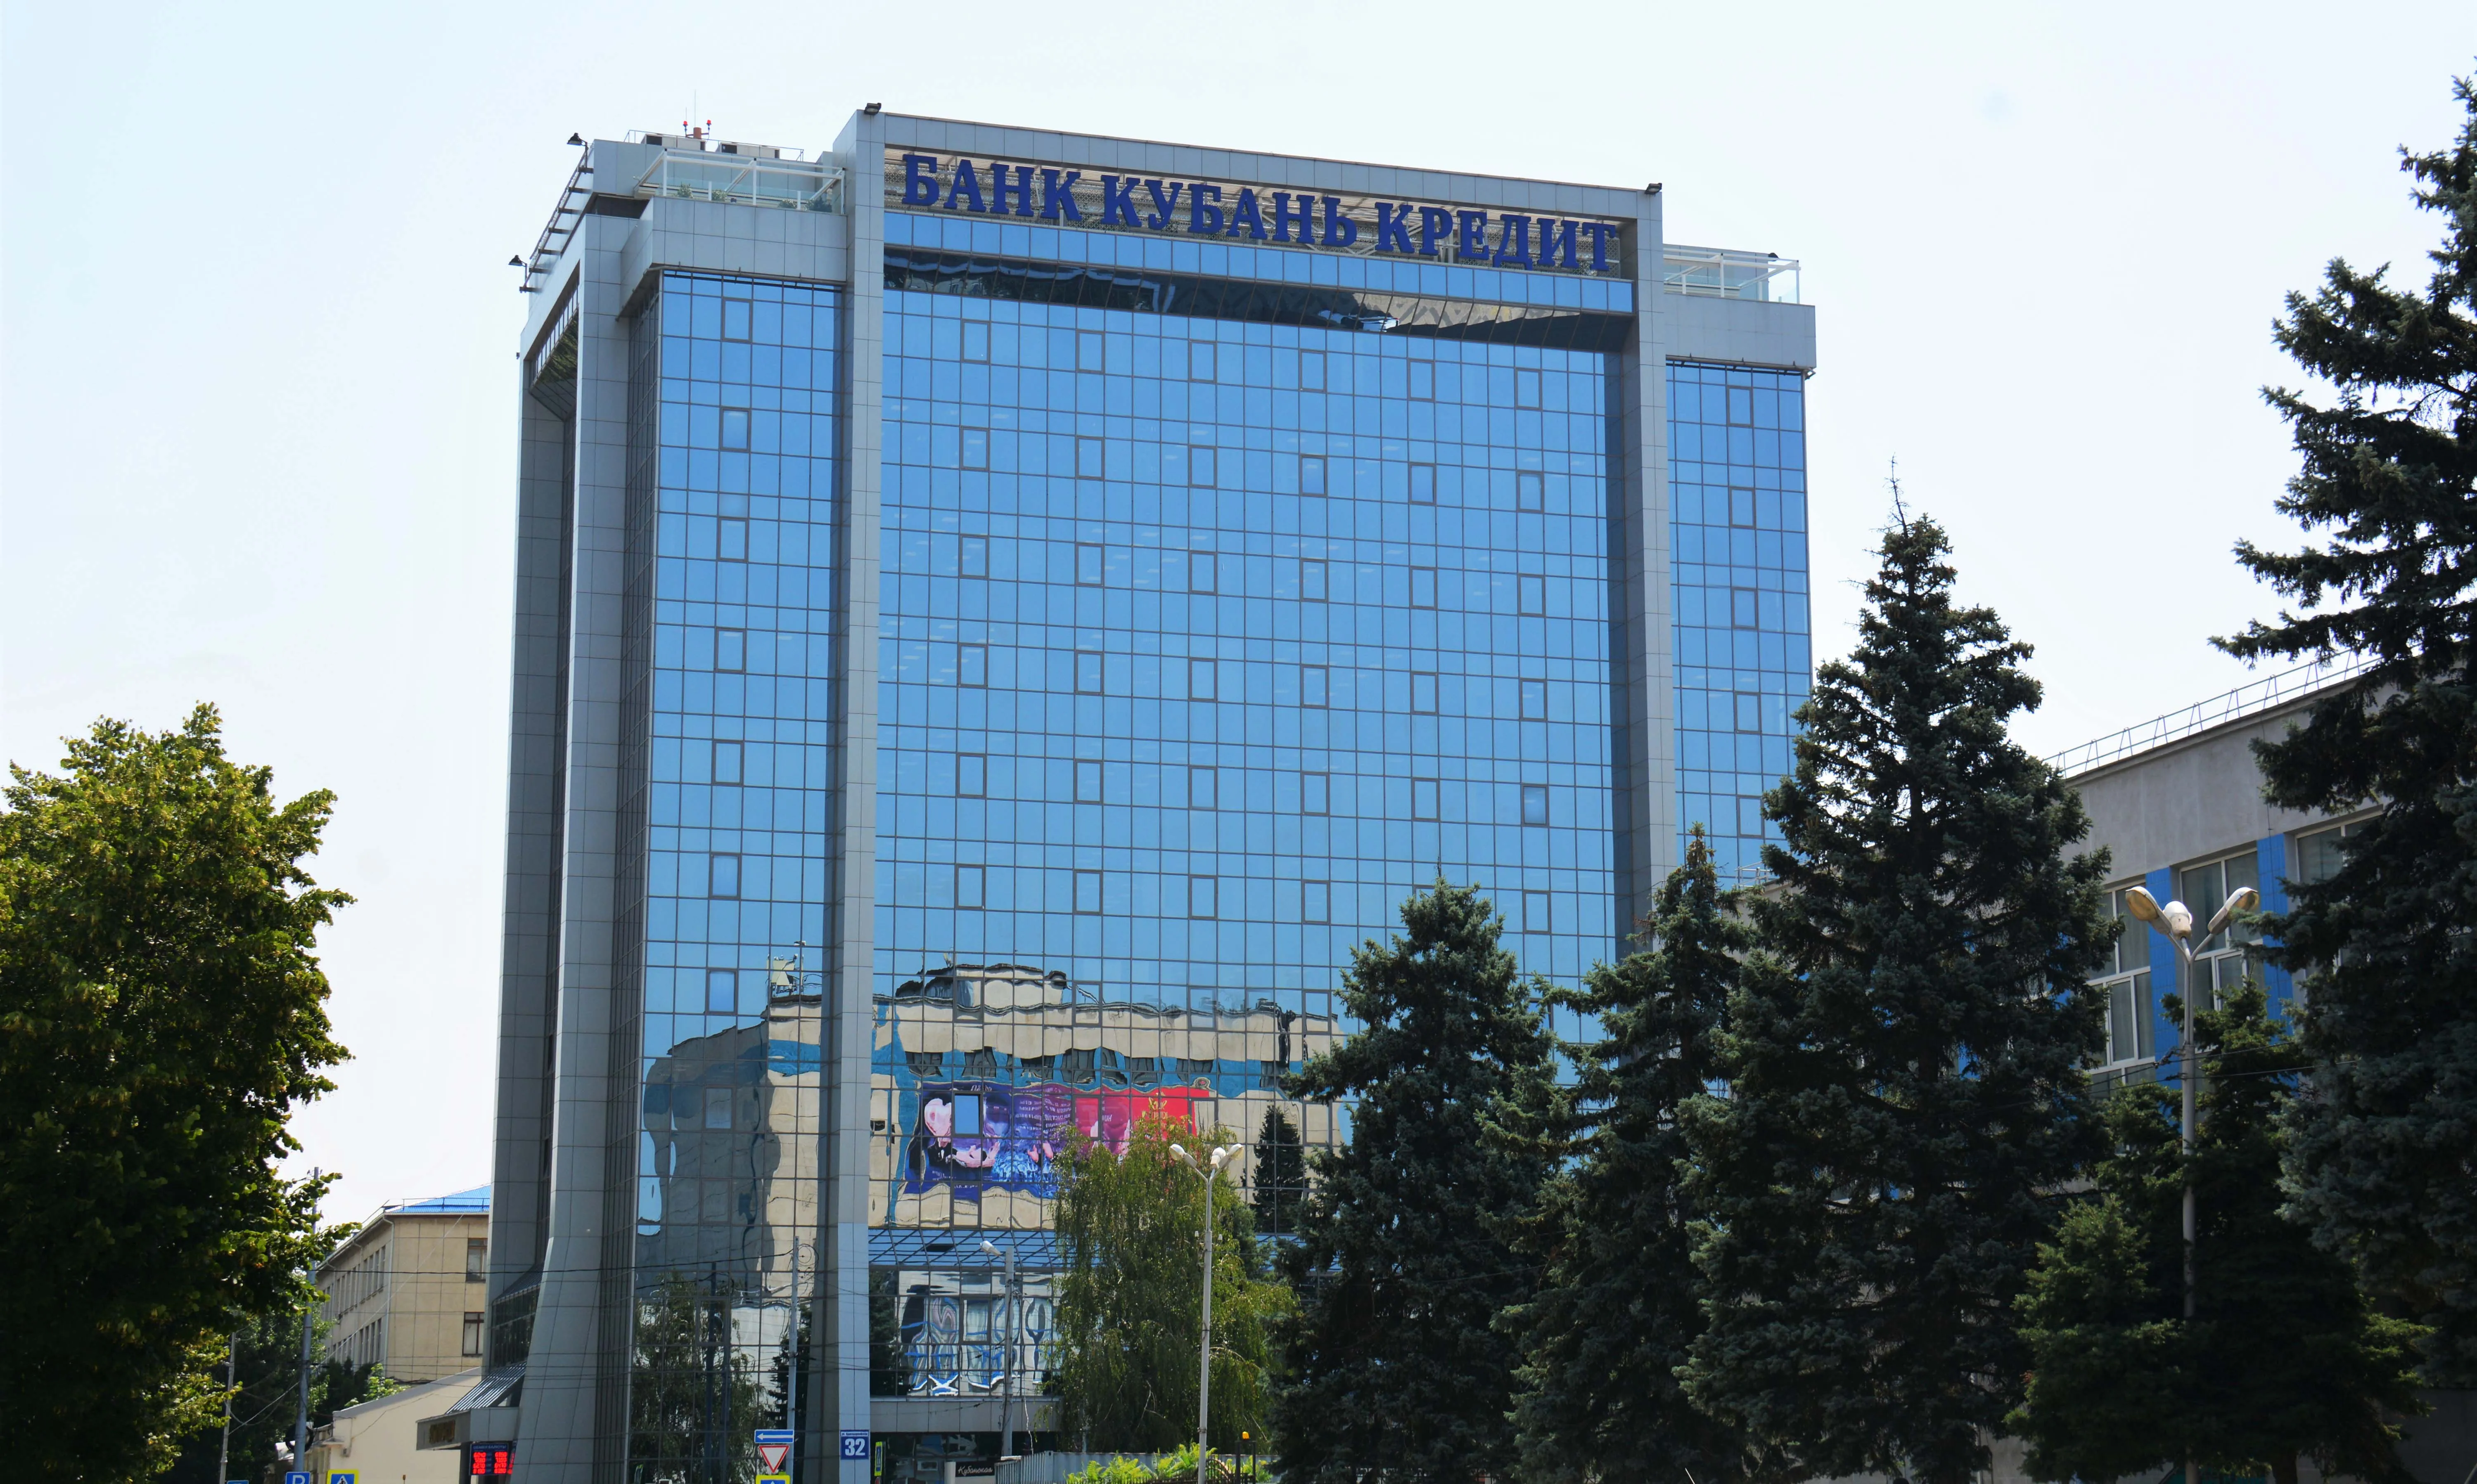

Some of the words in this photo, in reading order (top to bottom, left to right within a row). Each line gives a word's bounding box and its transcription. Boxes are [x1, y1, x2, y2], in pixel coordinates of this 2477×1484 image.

[901, 154, 1082, 221] БАНК
[1100, 174, 1357, 248] КУБАНЬ
[1375, 201, 1616, 271] КРЕДИТ
[844, 1438, 865, 1456] 32
[958, 1465, 993, 1477] Кубанская
